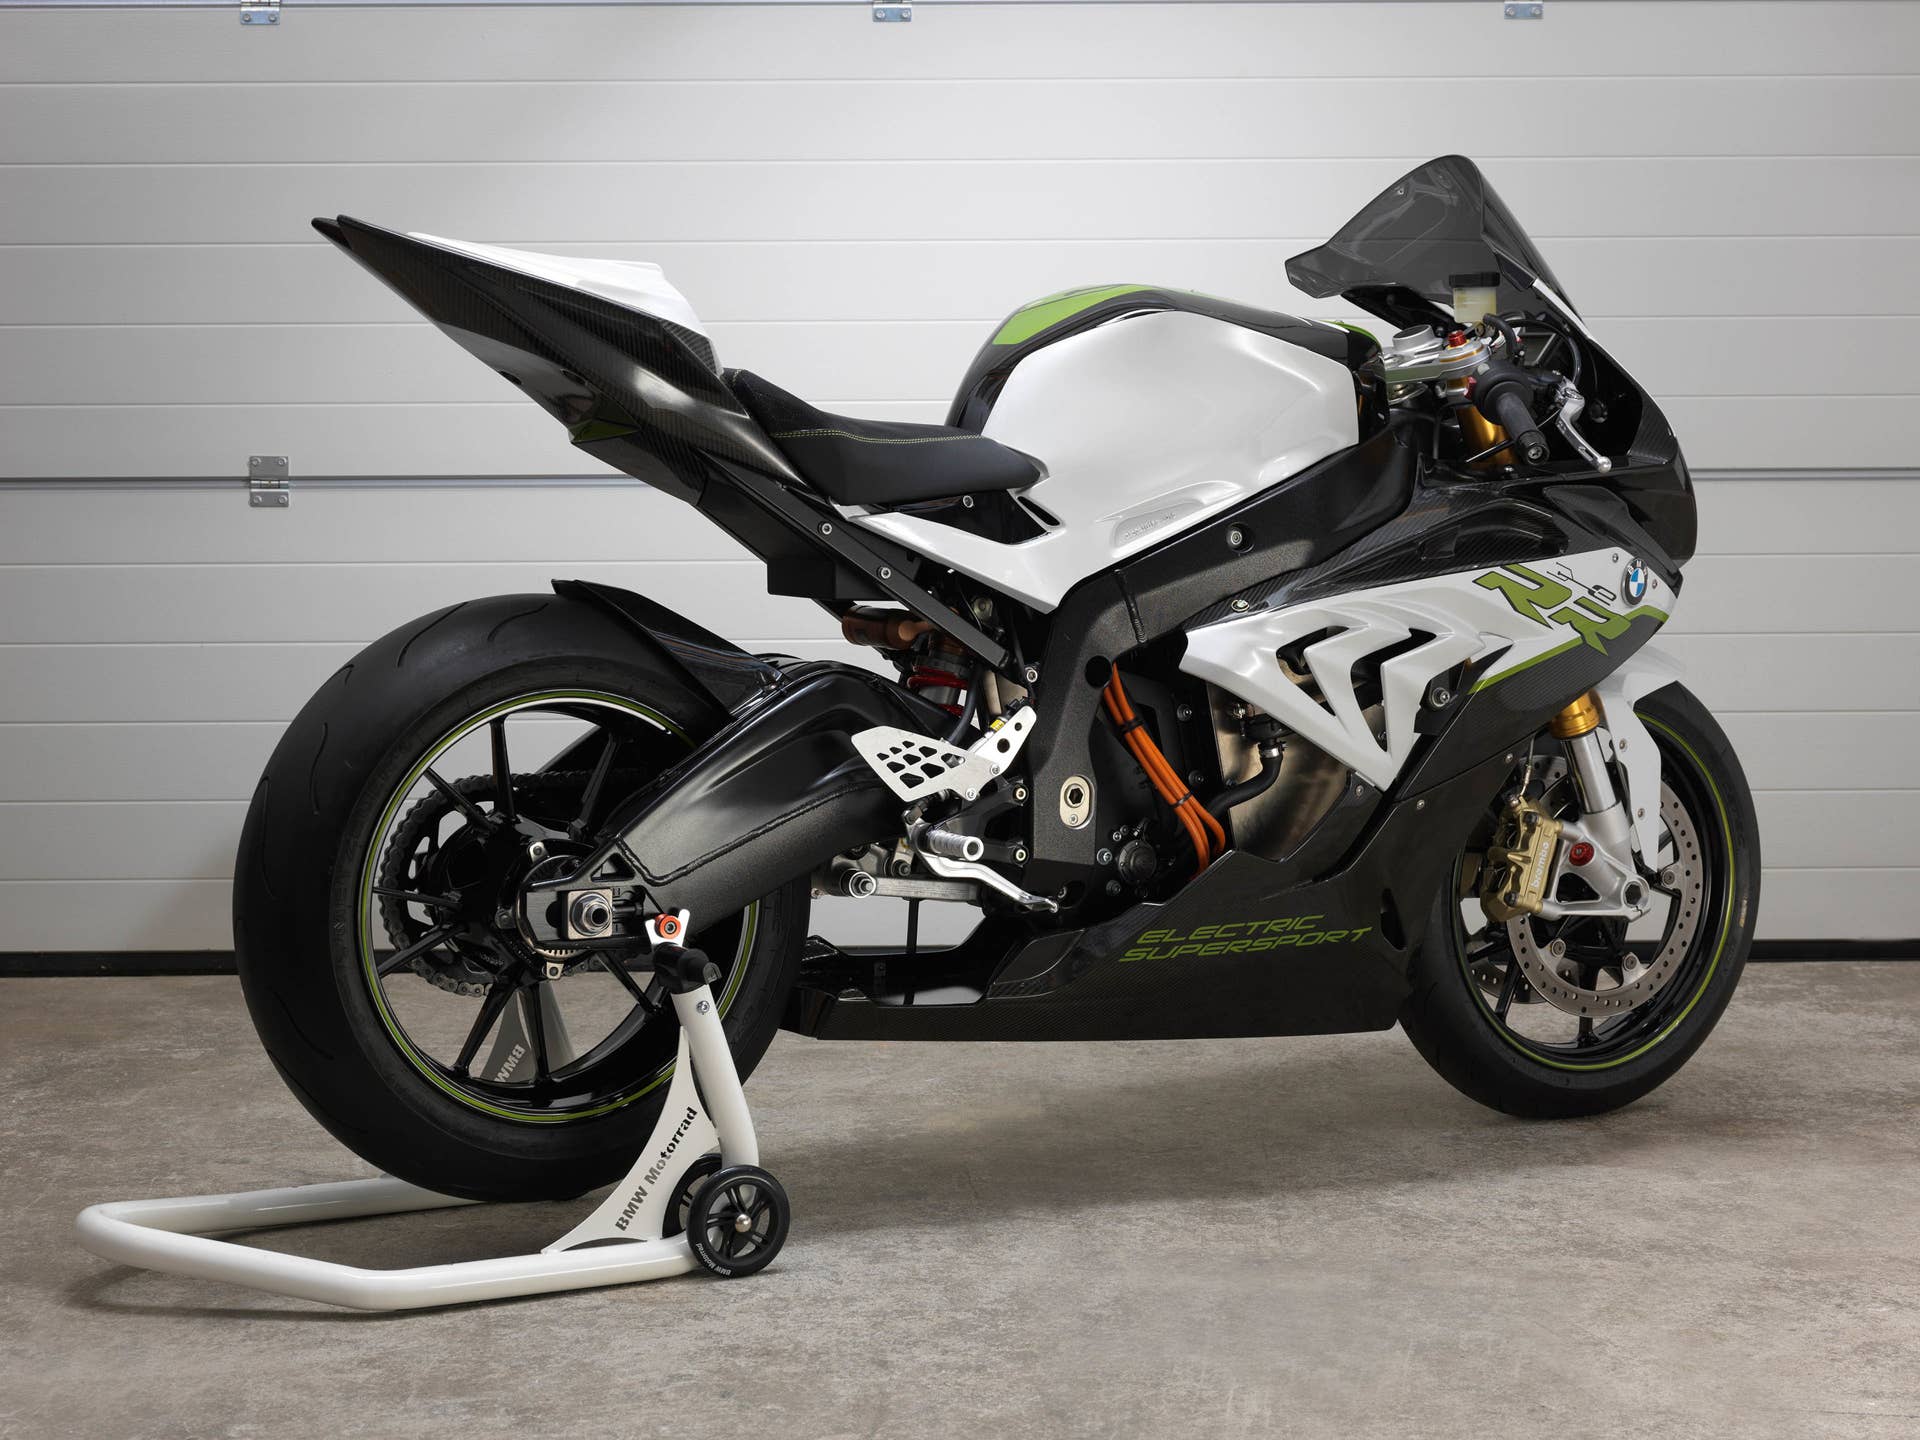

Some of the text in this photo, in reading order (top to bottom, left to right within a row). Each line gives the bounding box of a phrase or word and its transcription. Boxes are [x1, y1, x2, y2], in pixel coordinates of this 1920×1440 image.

[1531, 842, 1549, 887] brembo
[1118, 926, 1373, 962] SUPERSPORT
[1136, 914, 1326, 944] ELECTRIC
[615, 1106, 698, 1231] BMW Motorrad
